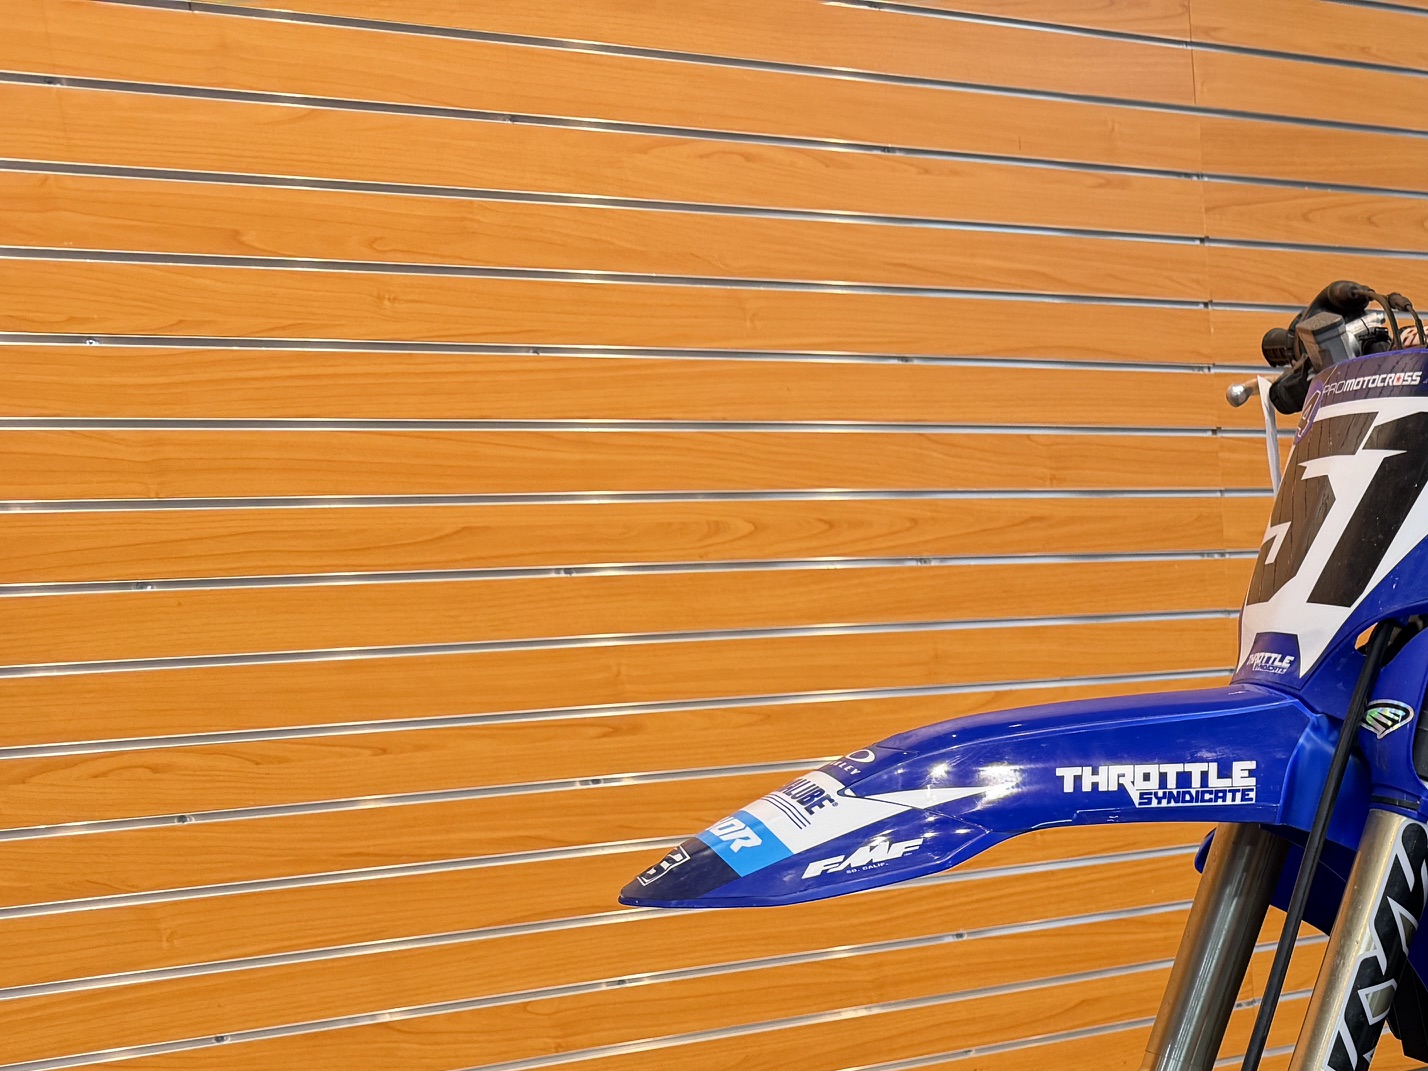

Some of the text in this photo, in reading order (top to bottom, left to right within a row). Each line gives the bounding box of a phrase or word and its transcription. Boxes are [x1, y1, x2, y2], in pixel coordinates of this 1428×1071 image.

[1056, 761, 1256, 793] THROTTLE
[1138, 788, 1255, 806] SYNDICATE
[801, 837, 924, 880] FMF
